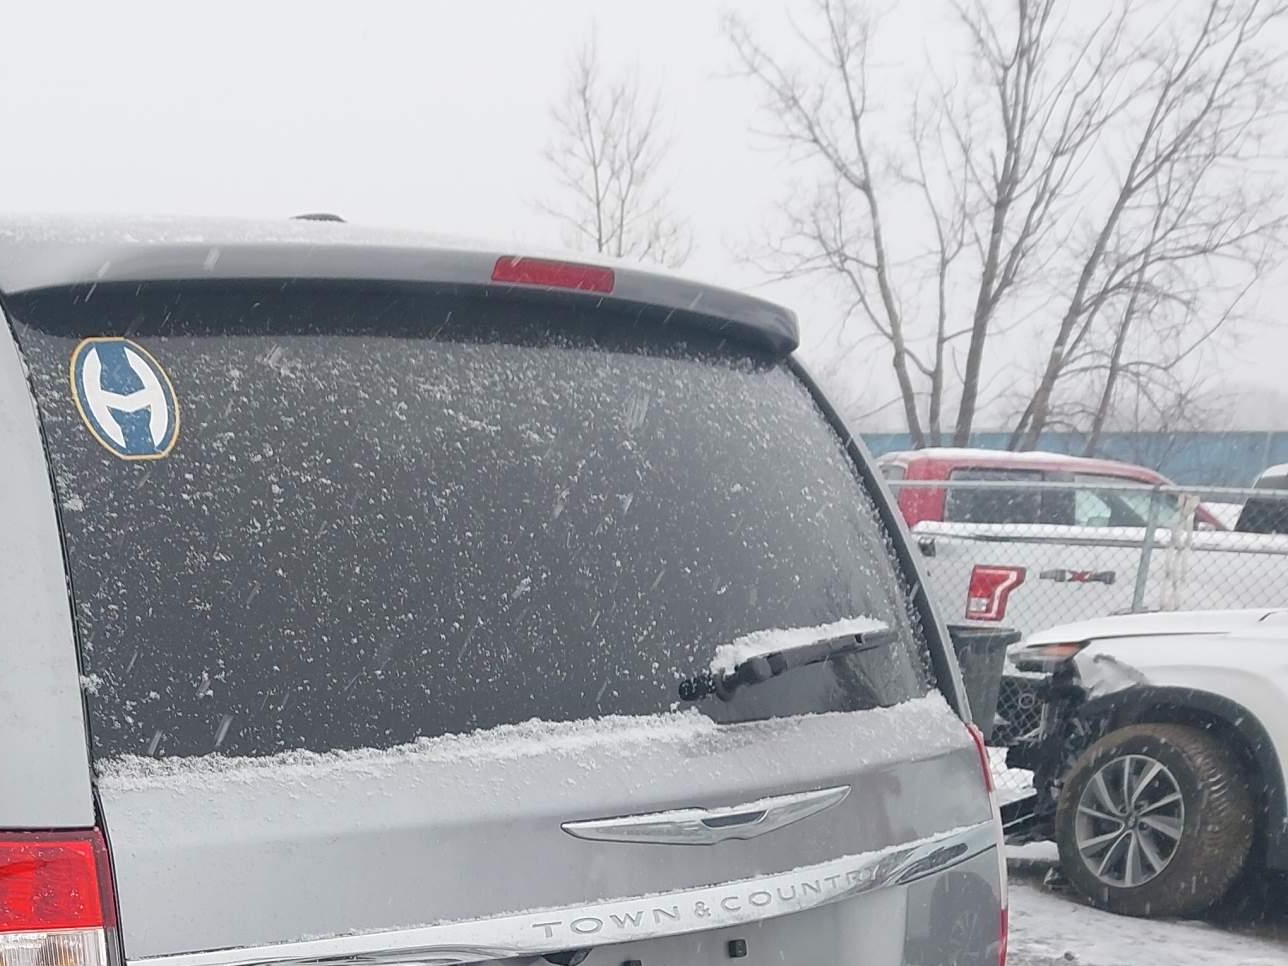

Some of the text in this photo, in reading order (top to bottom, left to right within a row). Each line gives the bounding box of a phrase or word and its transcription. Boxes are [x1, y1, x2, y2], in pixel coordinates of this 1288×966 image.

[532, 865, 881, 938] TOWN & COUNTRY
